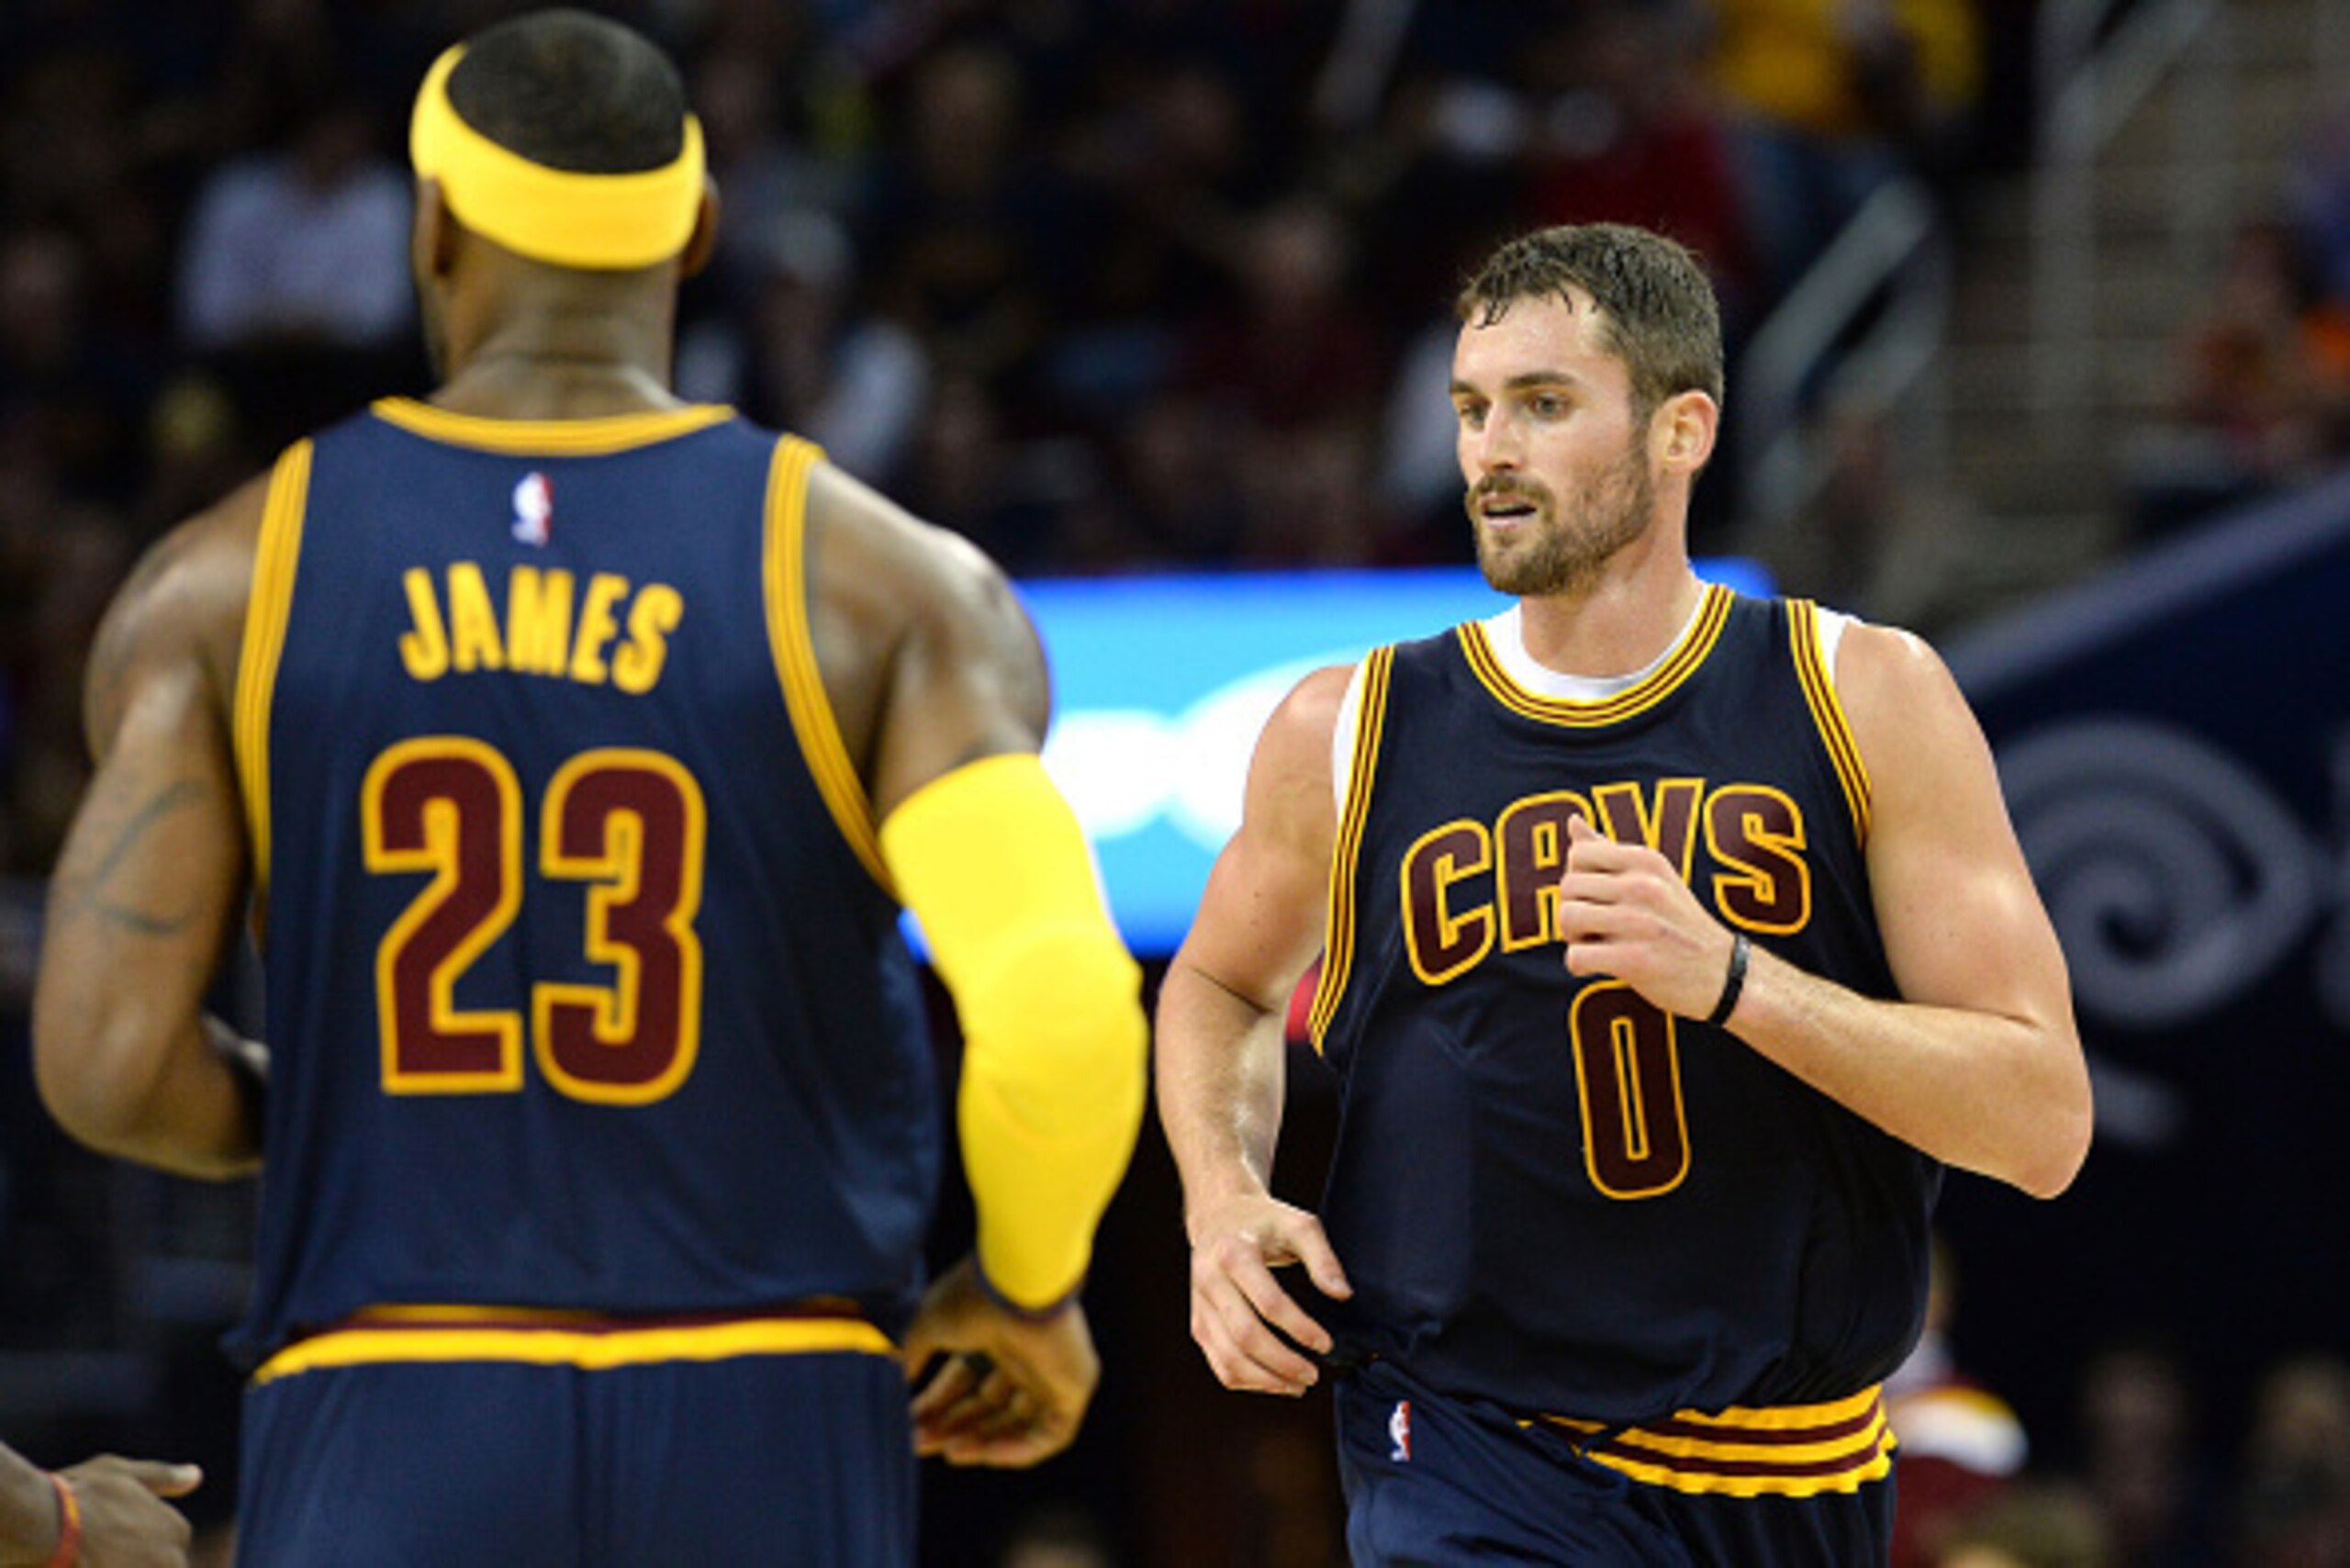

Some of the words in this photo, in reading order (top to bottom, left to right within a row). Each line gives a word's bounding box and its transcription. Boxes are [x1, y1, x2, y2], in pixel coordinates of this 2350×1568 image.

[398, 562, 685, 695] JAMES
[361, 735, 706, 1106] 23
[1400, 778, 1812, 987] CAVS
[1570, 979, 1691, 1201] 0
